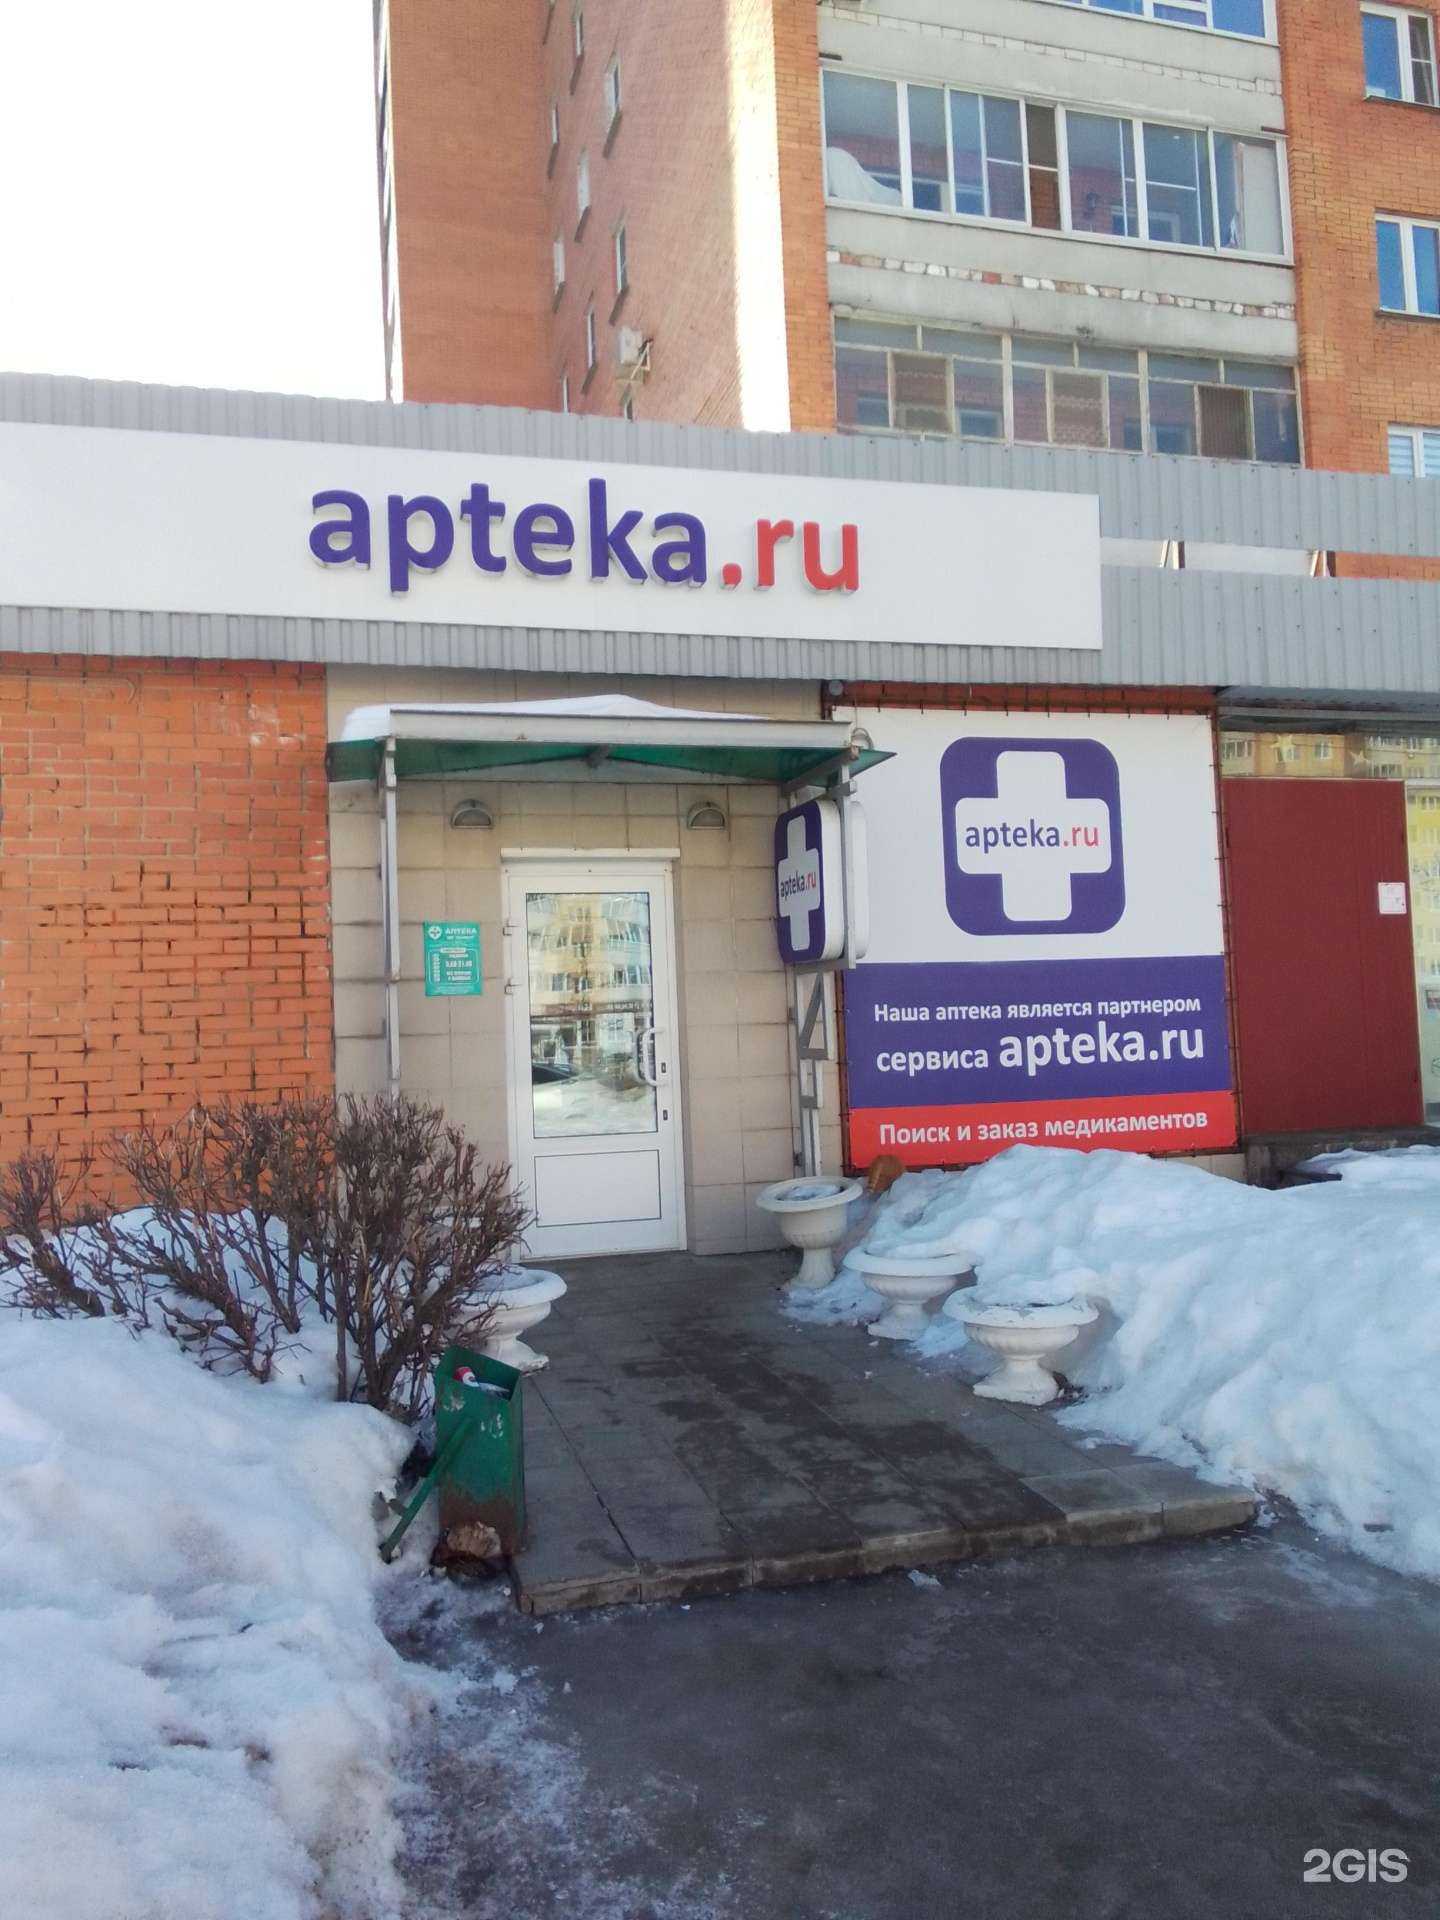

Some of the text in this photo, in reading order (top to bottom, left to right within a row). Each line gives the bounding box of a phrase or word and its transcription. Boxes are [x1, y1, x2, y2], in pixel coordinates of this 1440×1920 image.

[308, 477, 860, 597] apteka.ru
[965, 818, 1099, 854] apteka.ru
[779, 870, 817, 899] apteka.ru
[874, 998, 1201, 1022] Наша аптека является партнером
[876, 1020, 1204, 1077] сервиса apteka.ru
[879, 1111, 1208, 1145] Поиск и заказ медикаментов
